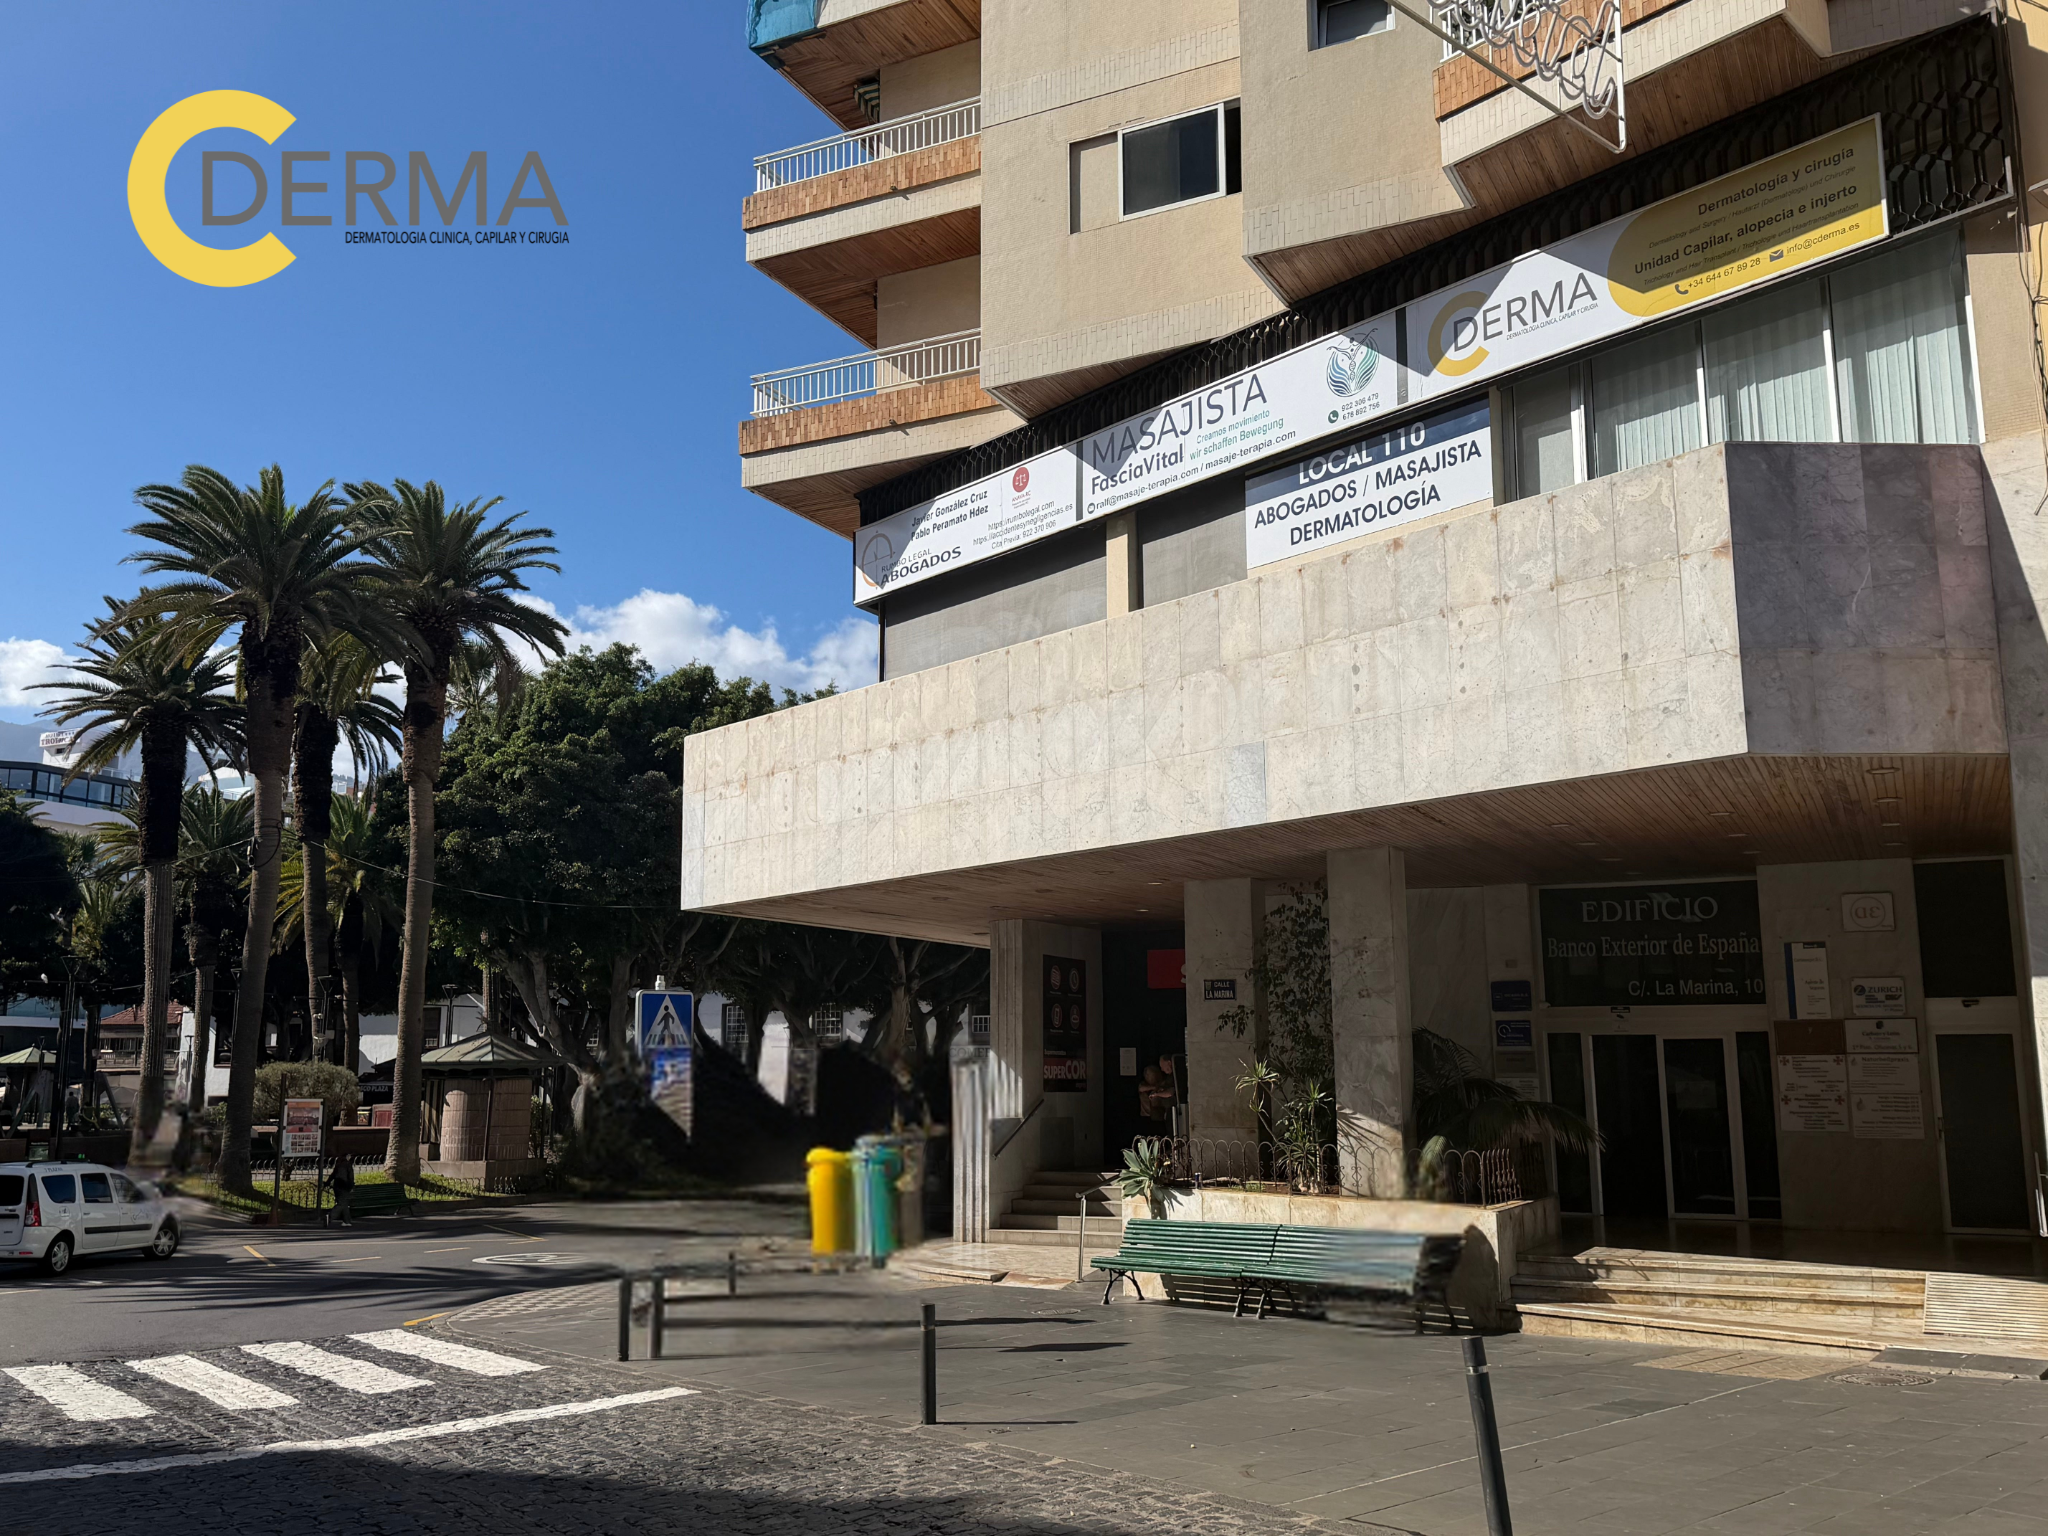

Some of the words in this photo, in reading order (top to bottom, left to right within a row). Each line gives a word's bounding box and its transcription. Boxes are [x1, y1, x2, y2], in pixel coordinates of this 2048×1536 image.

[1698, 174, 1788, 215] Dermatología
[1791, 168, 1800, 182] y
[1804, 148, 1854, 174] cirugía
[1649, 231, 1687, 249] Dermatology
[1688, 225, 1701, 234] and
[1702, 217, 1726, 229] Surgery
[1809, 178, 1823, 188] und
[1824, 165, 1856, 182] Chirurgie
[1634, 249, 1679, 274] Unidad
[1683, 232, 1733, 256] Capilar,
[1737, 208, 1794, 237] alopecia
[1798, 204, 1806, 214] e
[1810, 185, 1857, 210] injerto
[1675, 265, 1688, 274] and
[1777, 227, 1791, 237] und
[1791, 202, 1859, 232] Haartransplantation
[1786, 222, 1860, 254] info@cderma.es
[1688, 277, 1703, 289] +34
[1705, 271, 1722, 284] 644
[1723, 267, 1734, 277] 67
[1736, 262, 1748, 272] 89
[1749, 257, 1761, 268] 28
[1506, 323, 1540, 341] DERMATOLOGIA
[1341, 402, 1353, 412] 922
[1367, 392, 1379, 402] 479
[1092, 373, 1267, 470] MASAJISTA
[1189, 449, 1202, 461] wir
[1203, 434, 1238, 457] schaffen
[1240, 417, 1284, 444] Bewegung
[1196, 425, 1227, 444] Creamos
[1228, 409, 1270, 434] movimiento
[1091, 443, 1184, 495] FasciaVital
[1096, 466, 1198, 510] ralf@masaje-terapia.com
[1205, 429, 1296, 471] masaje-terapia.com
[1299, 440, 1373, 485] LOCAL
[1382, 421, 1426, 457] 110
[1254, 479, 1357, 529] ABOGADOS
[1375, 439, 1482, 490] MASAJISTA
[911, 511, 934, 527] Javier
[935, 498, 968, 518] González
[970, 490, 988, 503] Cruz
[911, 527, 930, 541] Pablo
[932, 512, 967, 533] Peramato
[969, 505, 989, 519] Hdez
[1290, 480, 1441, 546] DERMATOLOGÍA
[880, 546, 962, 585] ABOGADOS
[881, 557, 907, 573] RUMBO
[908, 548, 932, 562] LEGAL
[1581, 896, 1718, 923] EDIFICIO
[1547, 937, 1596, 958] Banco
[1601, 935, 1668, 957] Exterior
[1673, 933, 1693, 955] de
[1698, 931, 1761, 960] España
[1205, 990, 1213, 999] LA
[1213, 990, 1234, 999] MARINA
[1655, 980, 1675, 996] La
[1679, 979, 1739, 997] Marina,
[1744, 978, 1763, 994] 10
[1867, 986, 1903, 994] ZURICH
